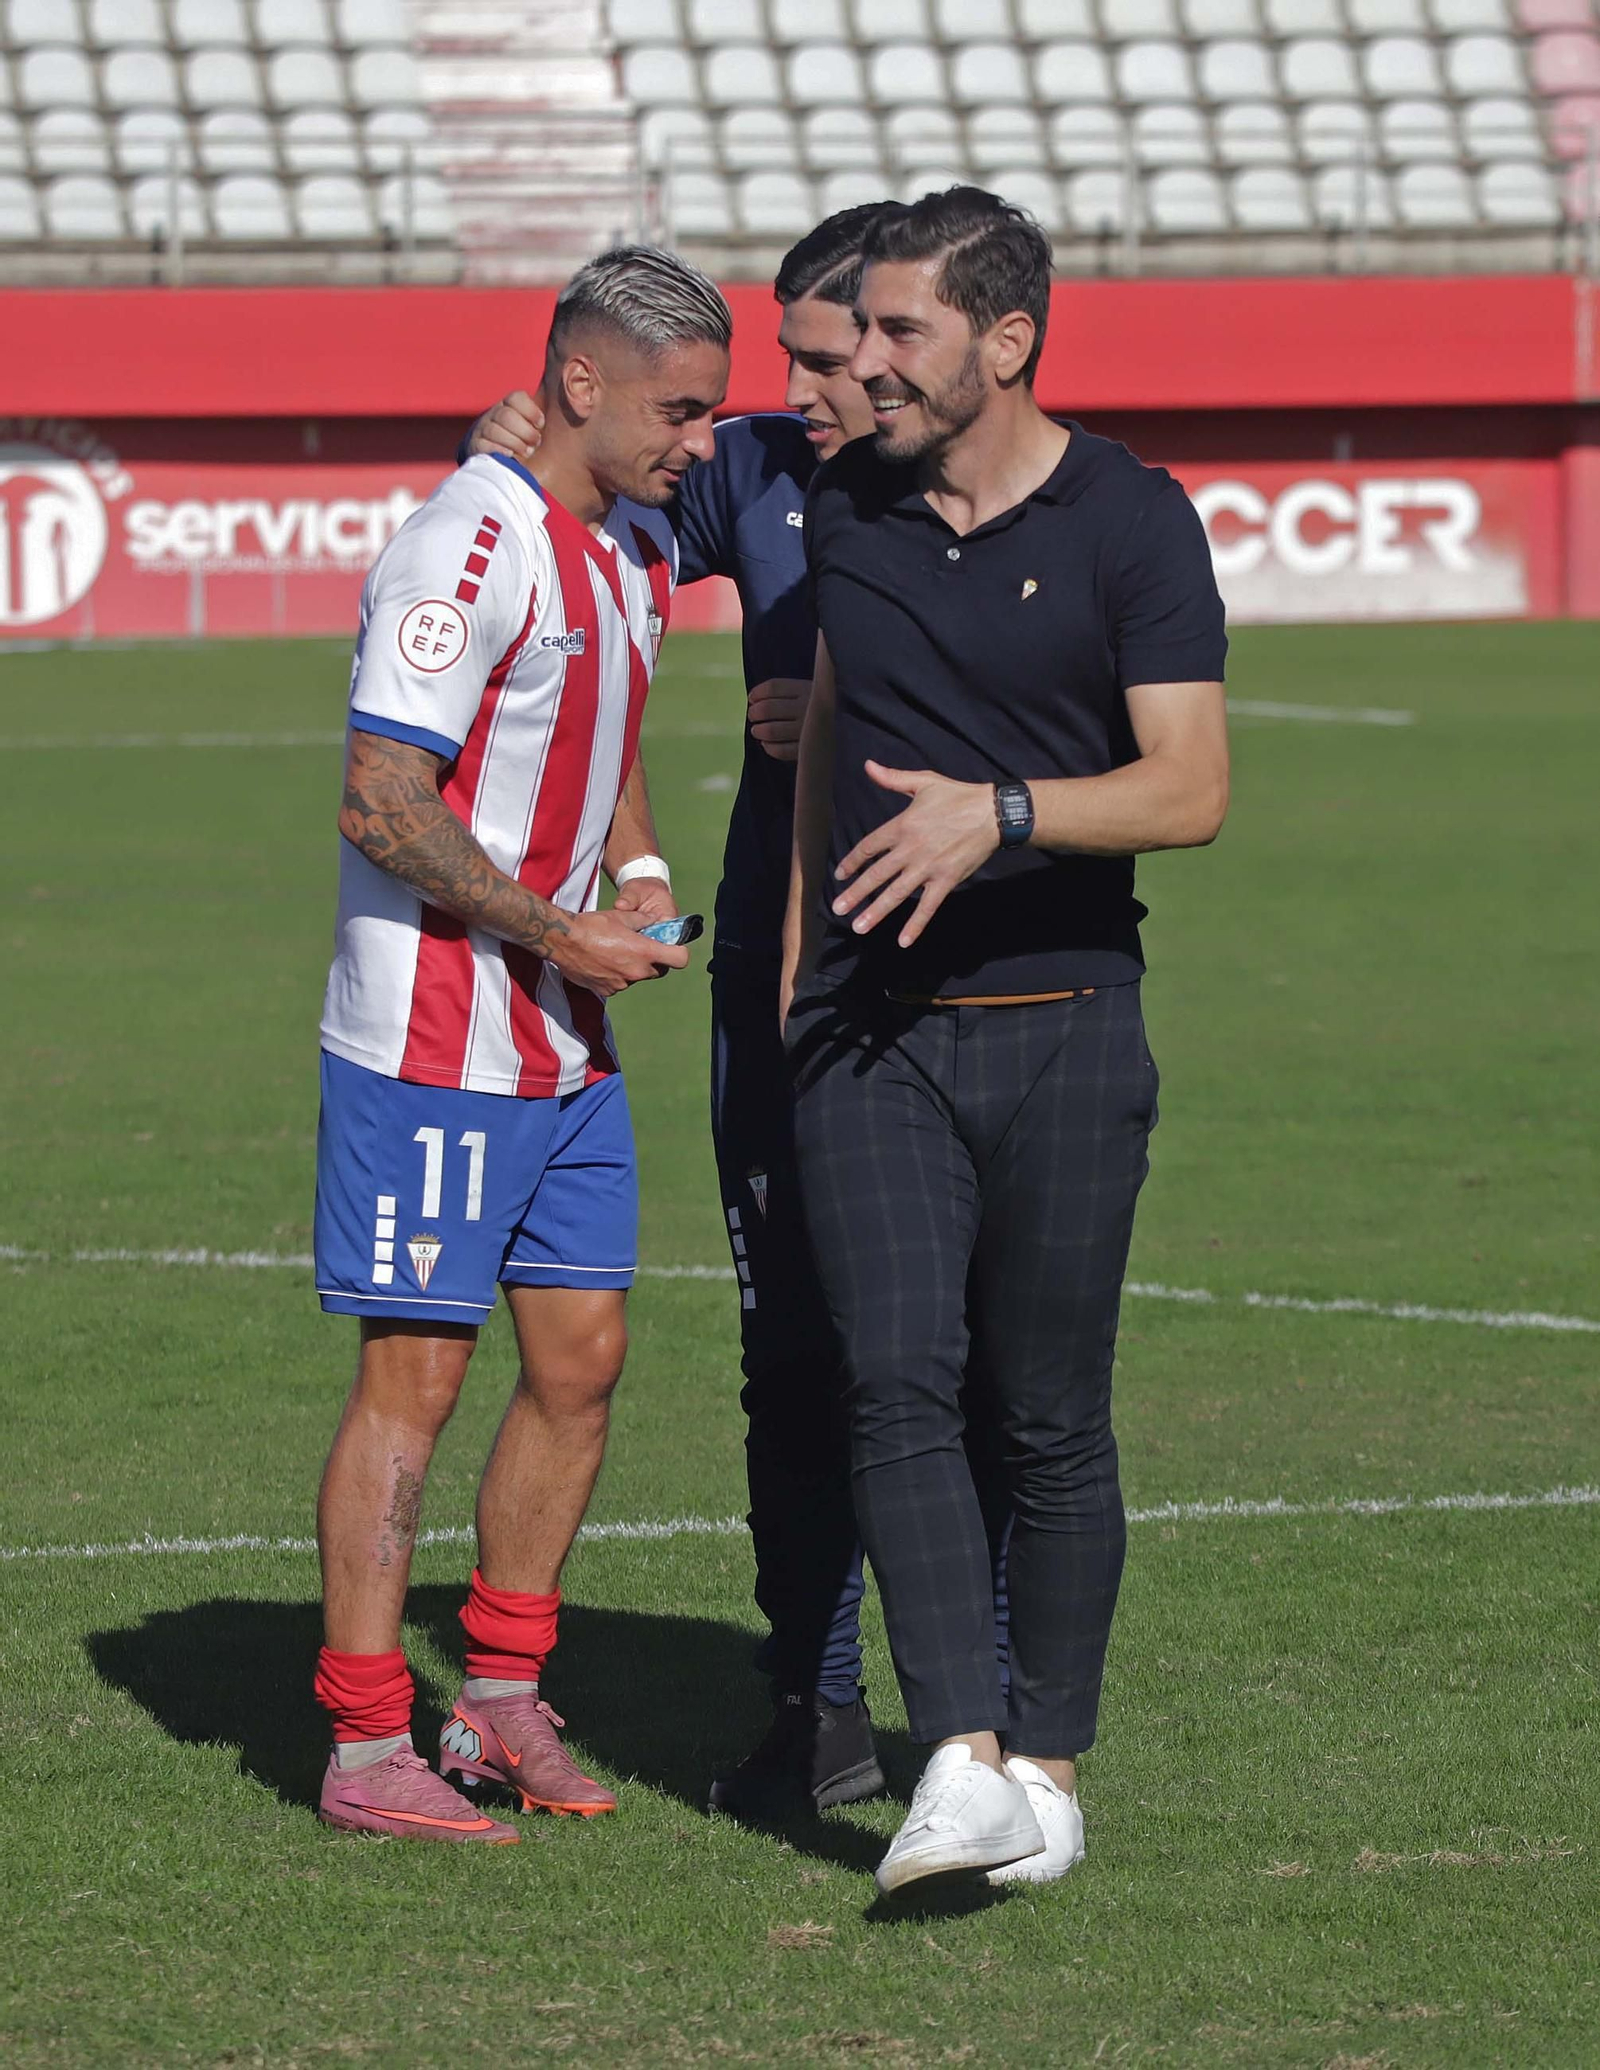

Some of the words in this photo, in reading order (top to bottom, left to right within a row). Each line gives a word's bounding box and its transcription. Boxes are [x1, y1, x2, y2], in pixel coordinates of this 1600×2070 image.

[1191, 478, 1483, 576] CCER
[540, 630, 584, 651] capelli
[413, 1126, 486, 1221] 11
